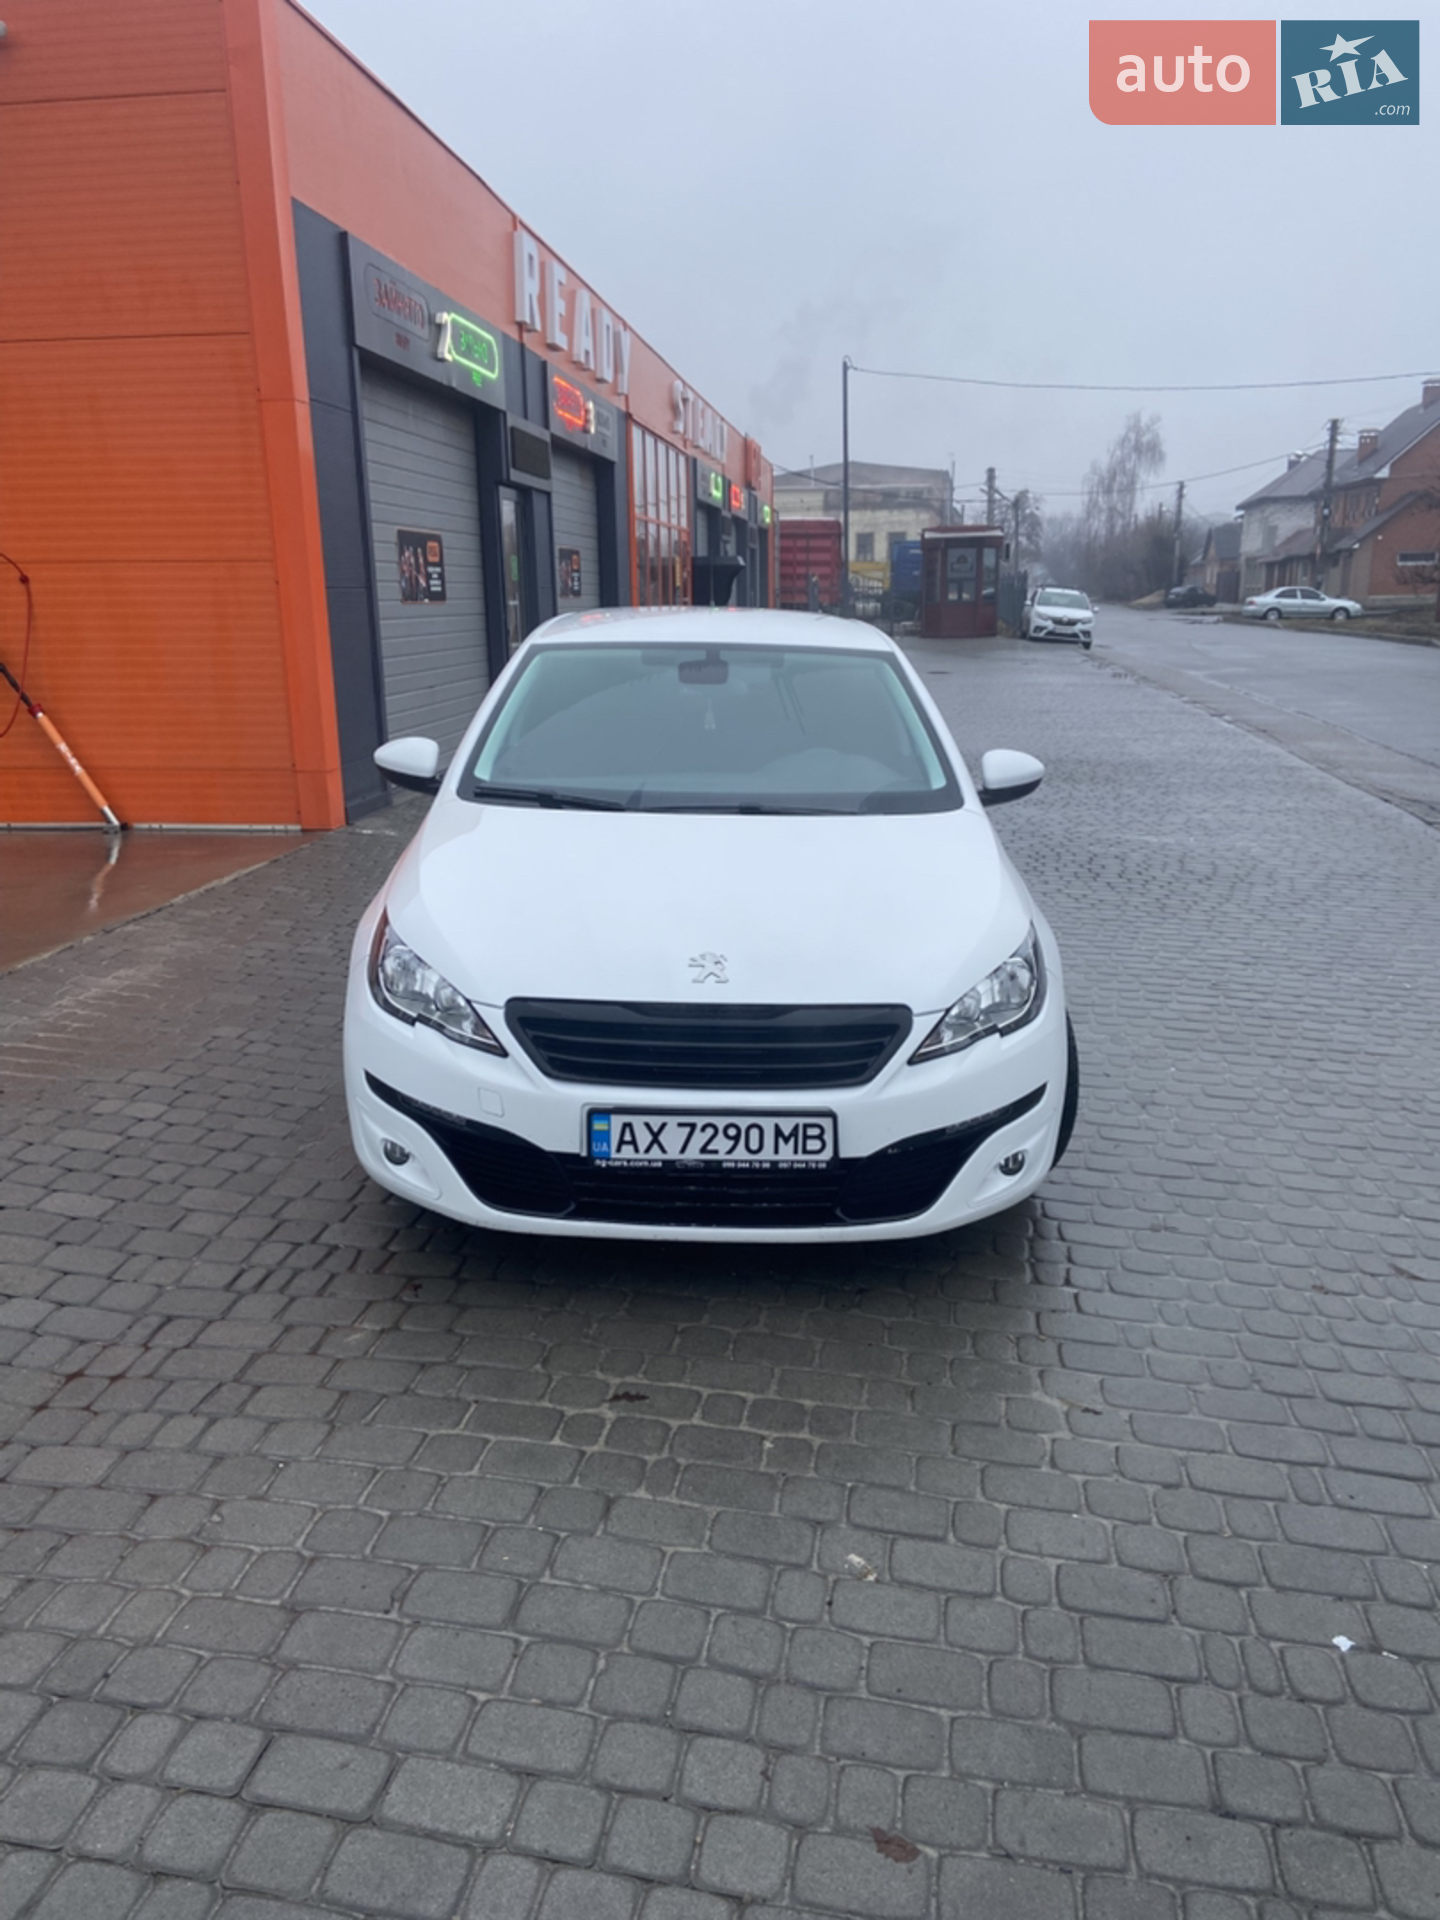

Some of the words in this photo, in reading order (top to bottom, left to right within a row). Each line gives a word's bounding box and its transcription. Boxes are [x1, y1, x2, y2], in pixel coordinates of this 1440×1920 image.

[513, 230, 630, 395] READY
[592, 1141, 609, 1152] UA
[615, 1122, 668, 1155] AX
[676, 1122, 765, 1156] 7290
[774, 1123, 827, 1156] MB
